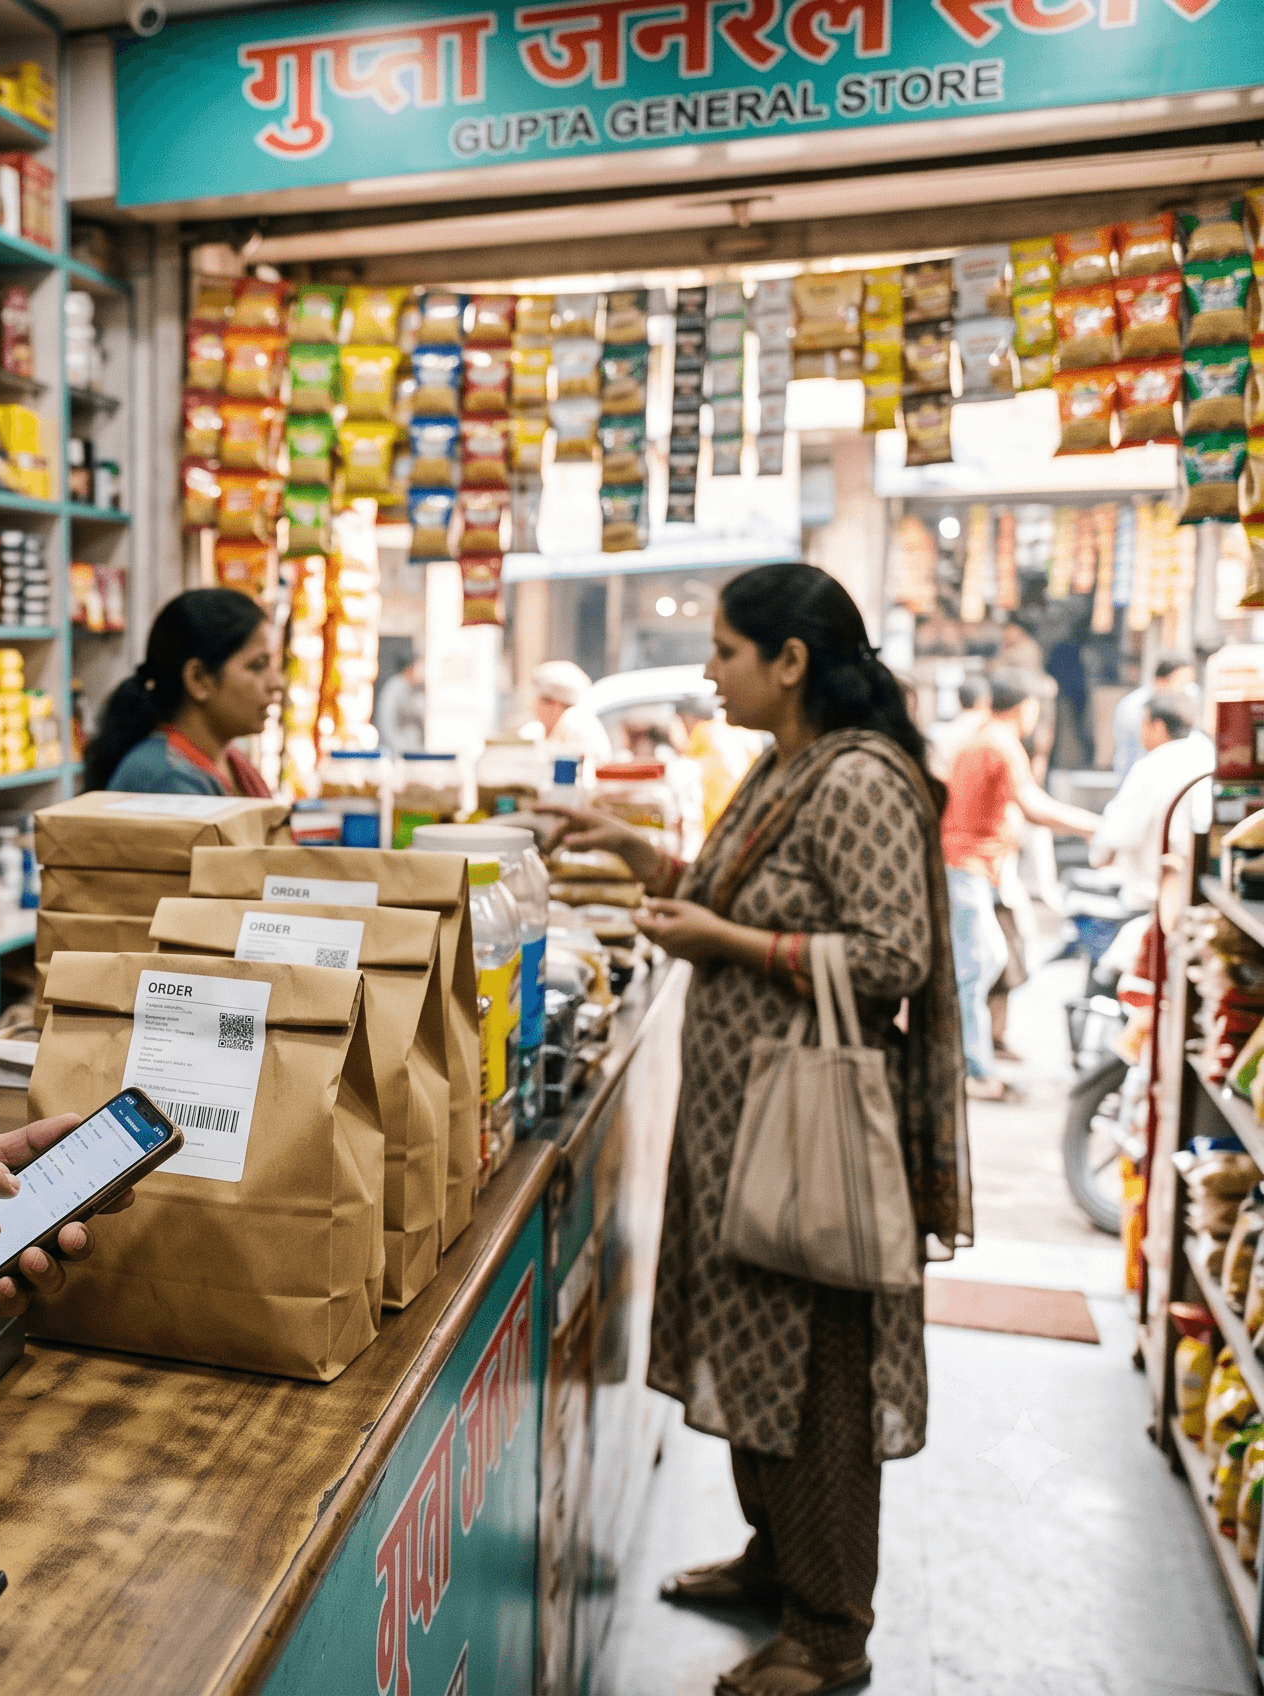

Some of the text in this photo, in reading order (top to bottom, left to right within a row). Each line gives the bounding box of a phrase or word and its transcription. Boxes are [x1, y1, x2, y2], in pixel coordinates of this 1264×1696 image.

[242, 14, 493, 157] गुप्ता
[516, 0, 890, 87] जनरल
[452, 63, 1000, 156] GUPTA GENERAL STORE
[270, 886, 311, 898] ORDER
[249, 921, 291, 935] ORDER
[147, 982, 193, 997] ORDER
